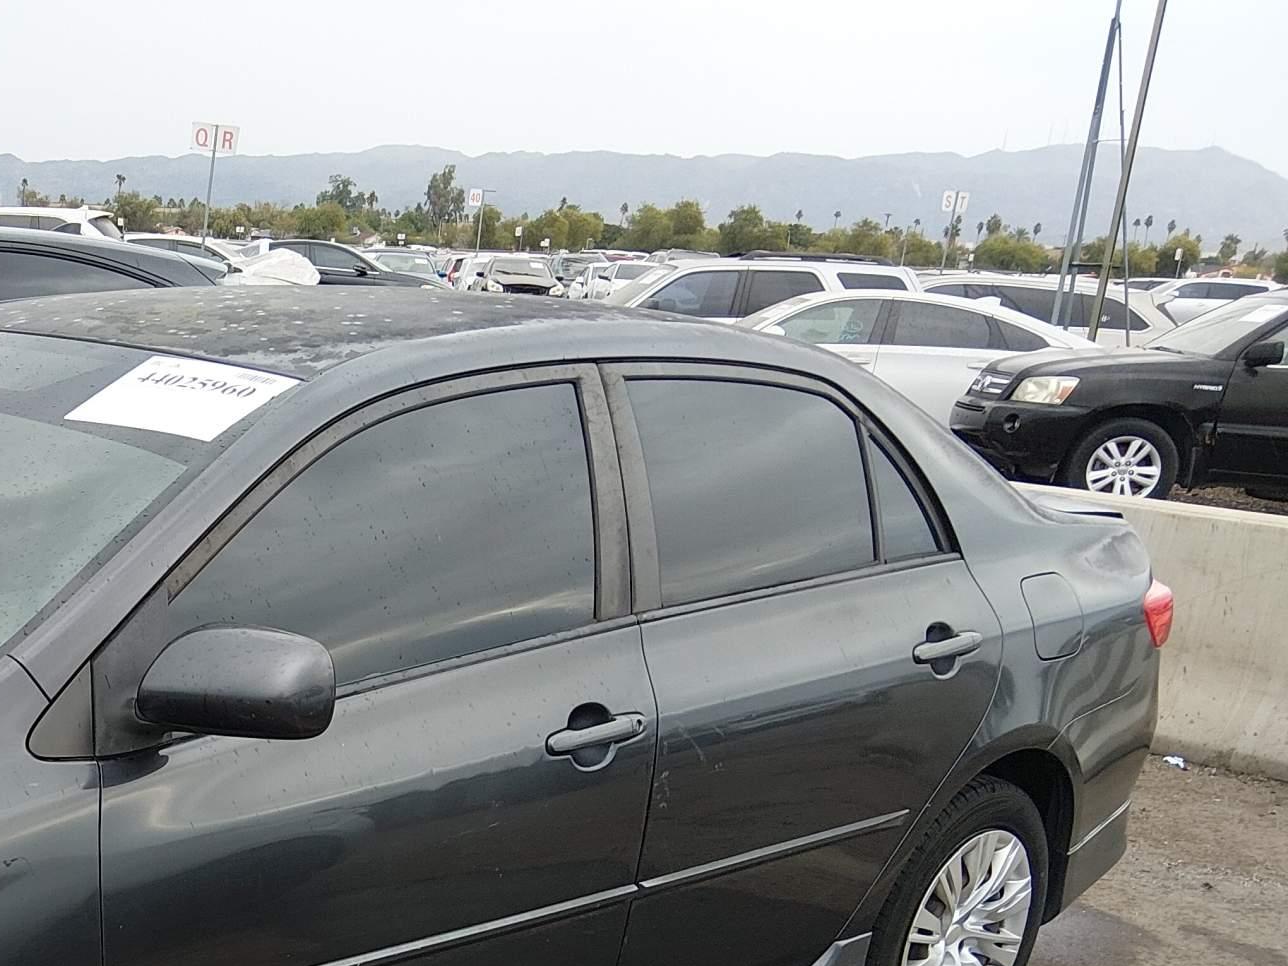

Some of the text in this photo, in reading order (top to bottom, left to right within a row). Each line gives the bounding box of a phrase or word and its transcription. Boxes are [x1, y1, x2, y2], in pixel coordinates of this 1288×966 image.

[195, 128, 234, 150] Q R
[470, 192, 481, 204] 40
[944, 194, 967, 209] S T
[137, 371, 257, 398] 44025960
